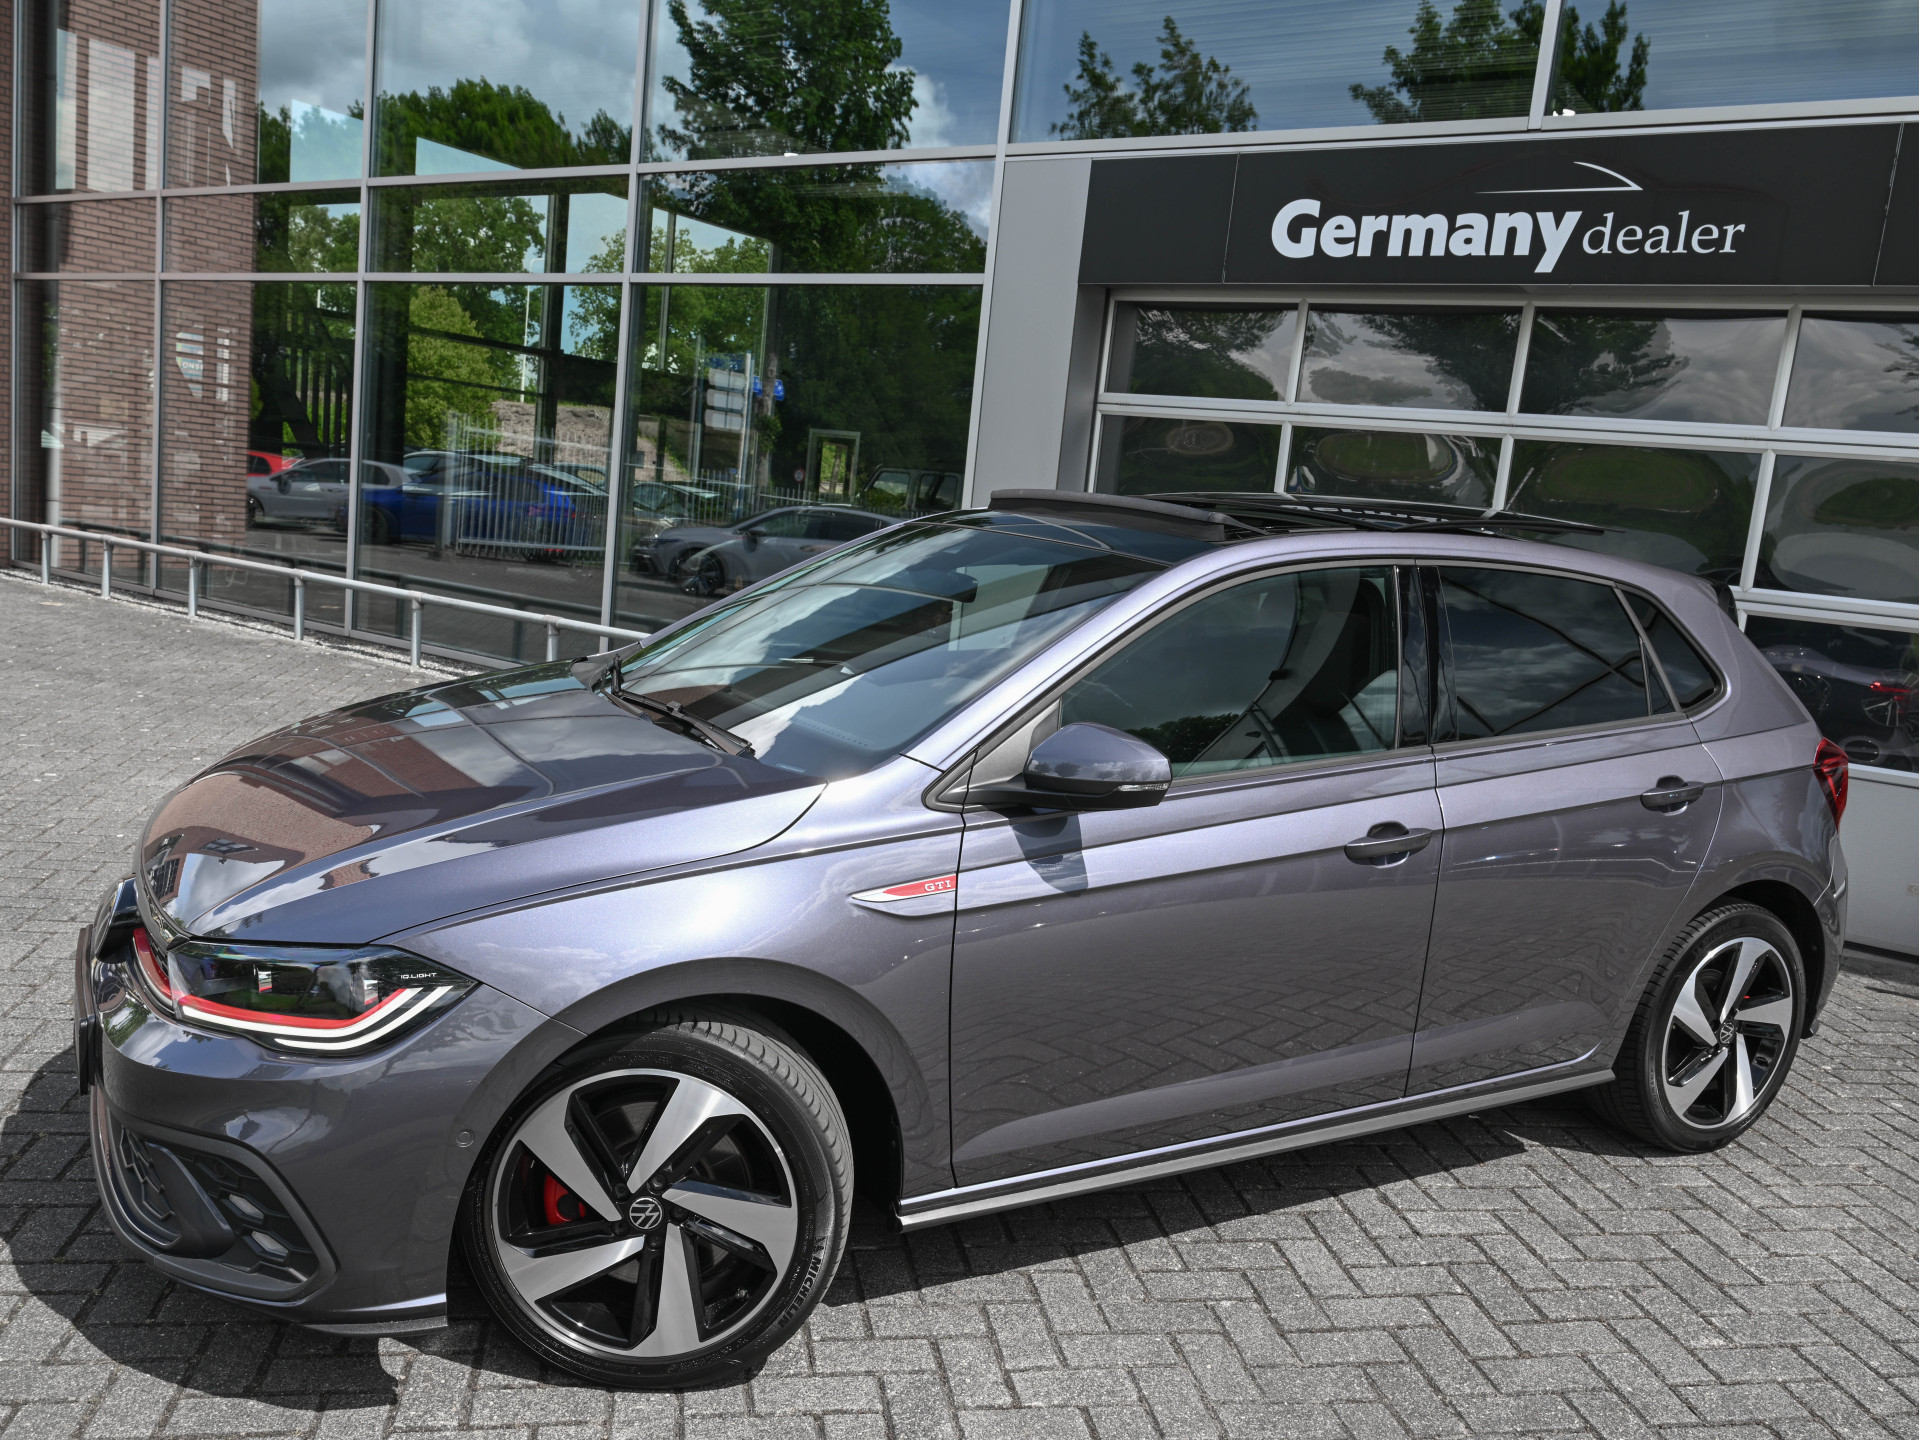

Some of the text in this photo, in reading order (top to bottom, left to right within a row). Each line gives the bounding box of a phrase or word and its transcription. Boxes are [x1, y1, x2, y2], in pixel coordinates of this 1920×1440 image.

[1271, 198, 1746, 274] Germany dealer
[924, 880, 952, 892] GTI
[777, 1255, 822, 1329] MICHELIN
